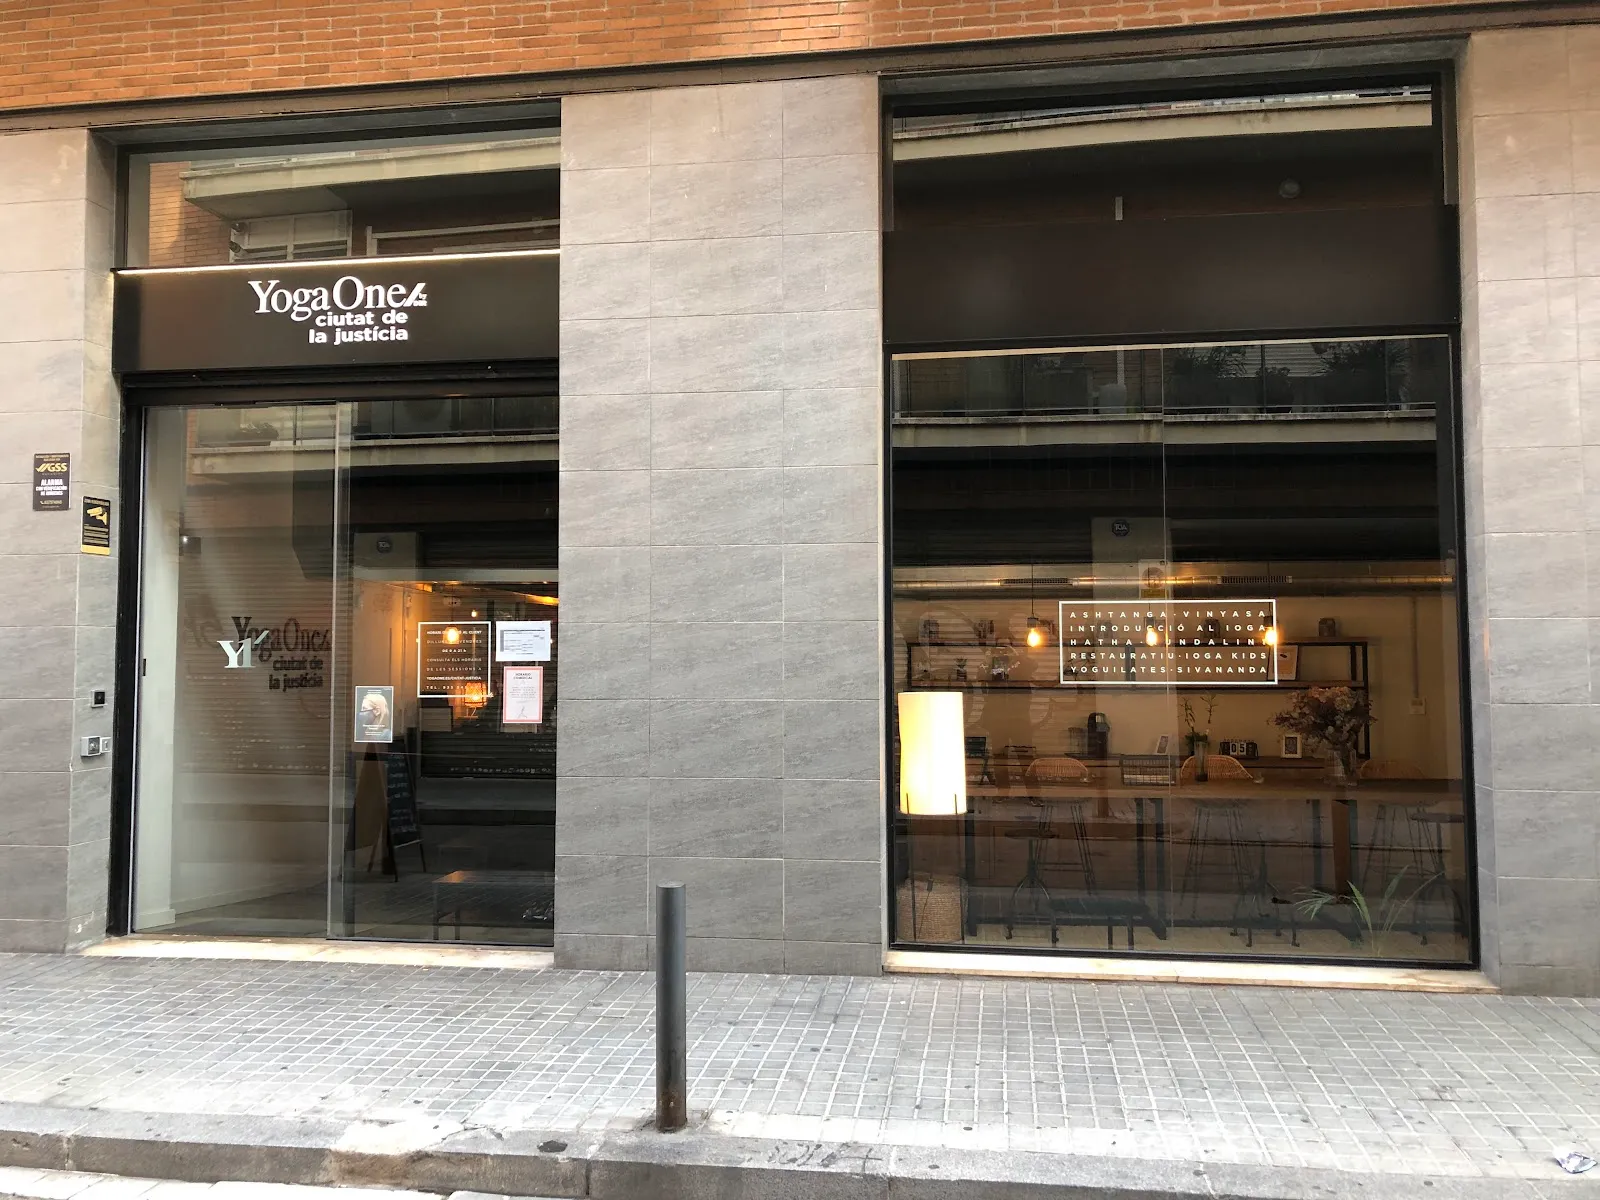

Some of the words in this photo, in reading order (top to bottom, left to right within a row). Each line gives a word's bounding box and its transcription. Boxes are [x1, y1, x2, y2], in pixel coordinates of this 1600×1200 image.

[315, 312, 374, 326] ciutat
[381, 310, 408, 324] de
[309, 329, 327, 343] la
[334, 326, 408, 345] justícia
